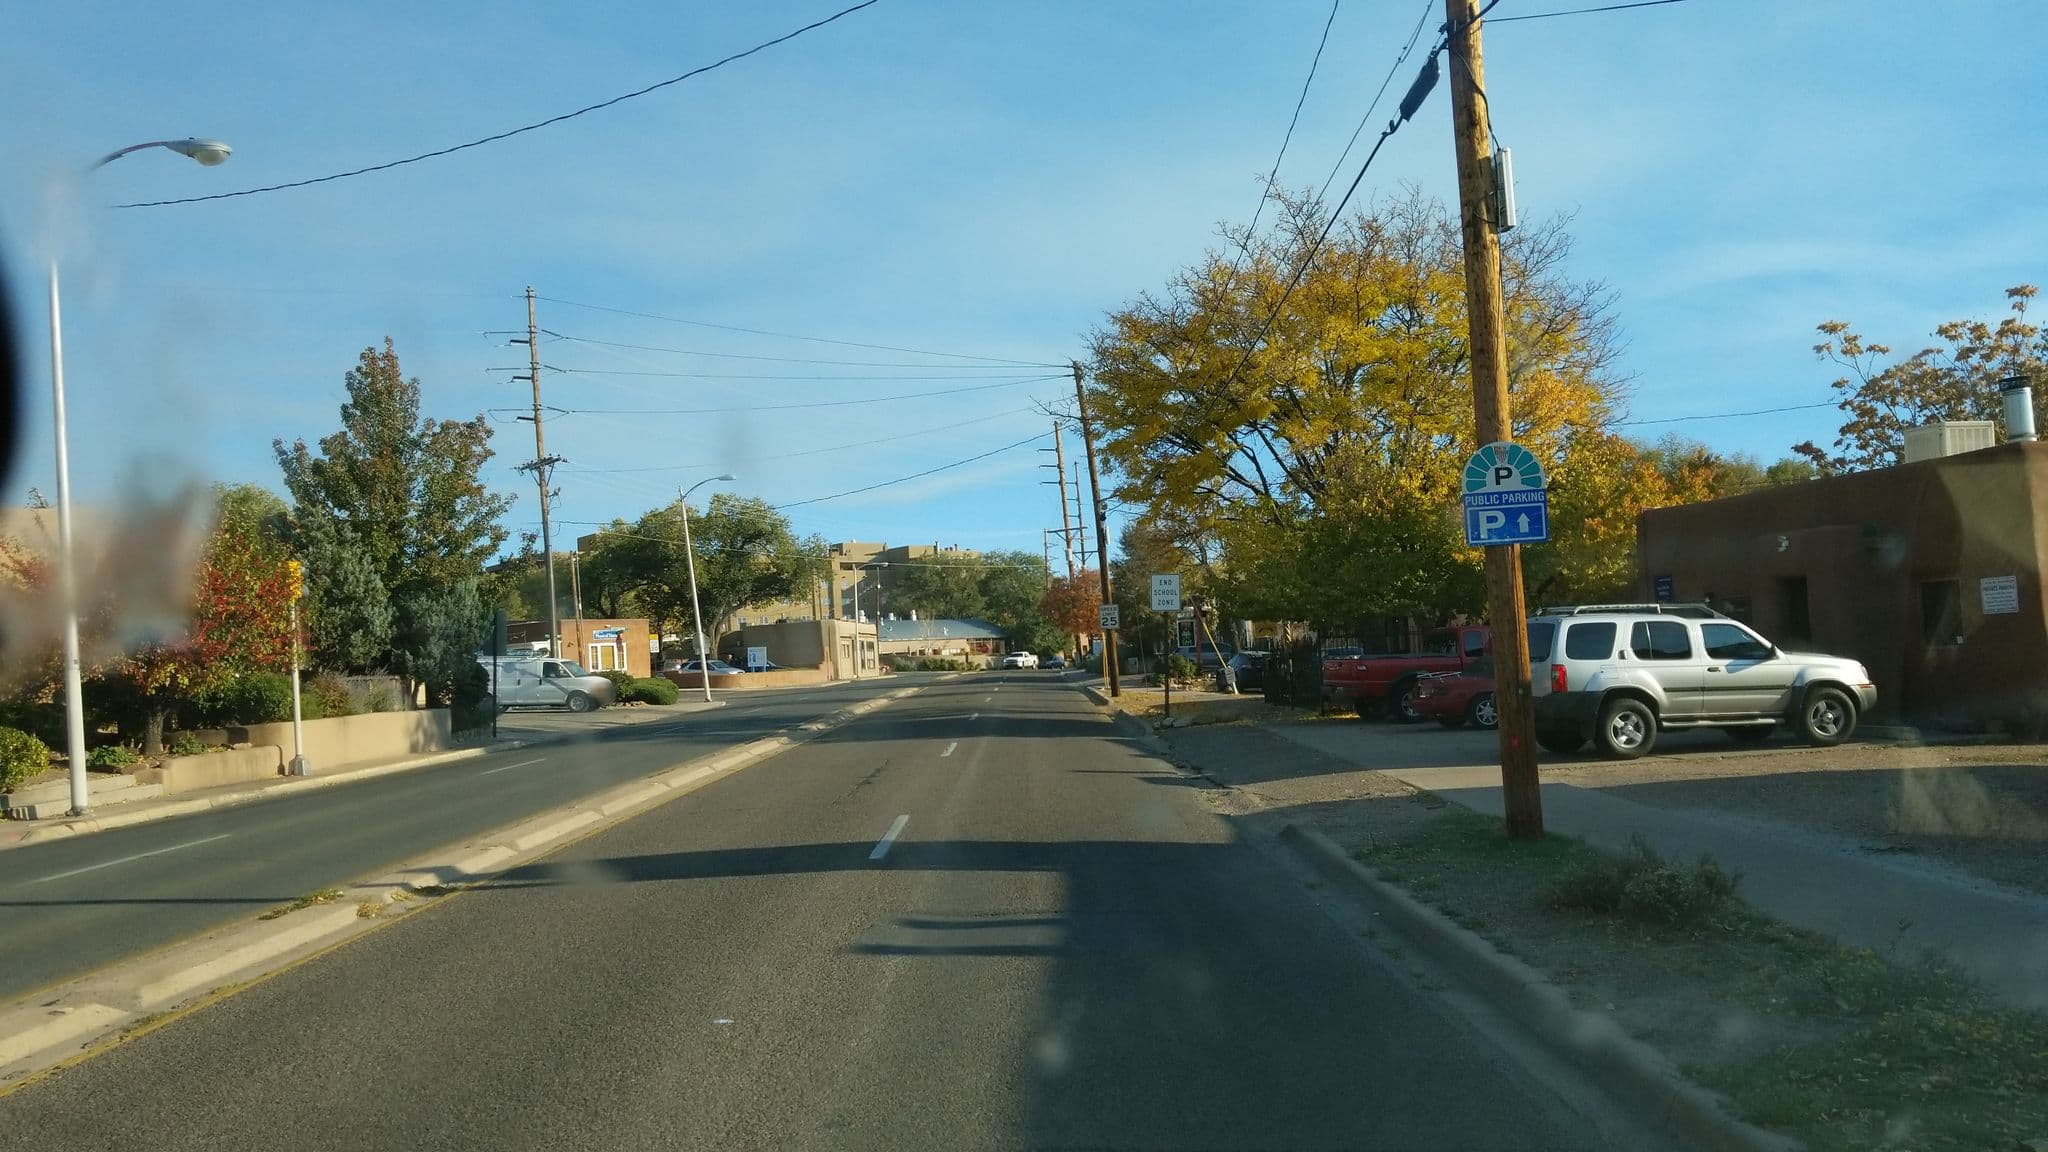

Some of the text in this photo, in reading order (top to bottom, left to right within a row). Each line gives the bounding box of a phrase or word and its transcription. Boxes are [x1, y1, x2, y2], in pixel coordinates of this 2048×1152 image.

[1494, 466, 1513, 486] P
[1465, 491, 1545, 507] PUBLIC PARKING
[1479, 510, 1506, 540] P
[1101, 616, 1118, 627] 25
